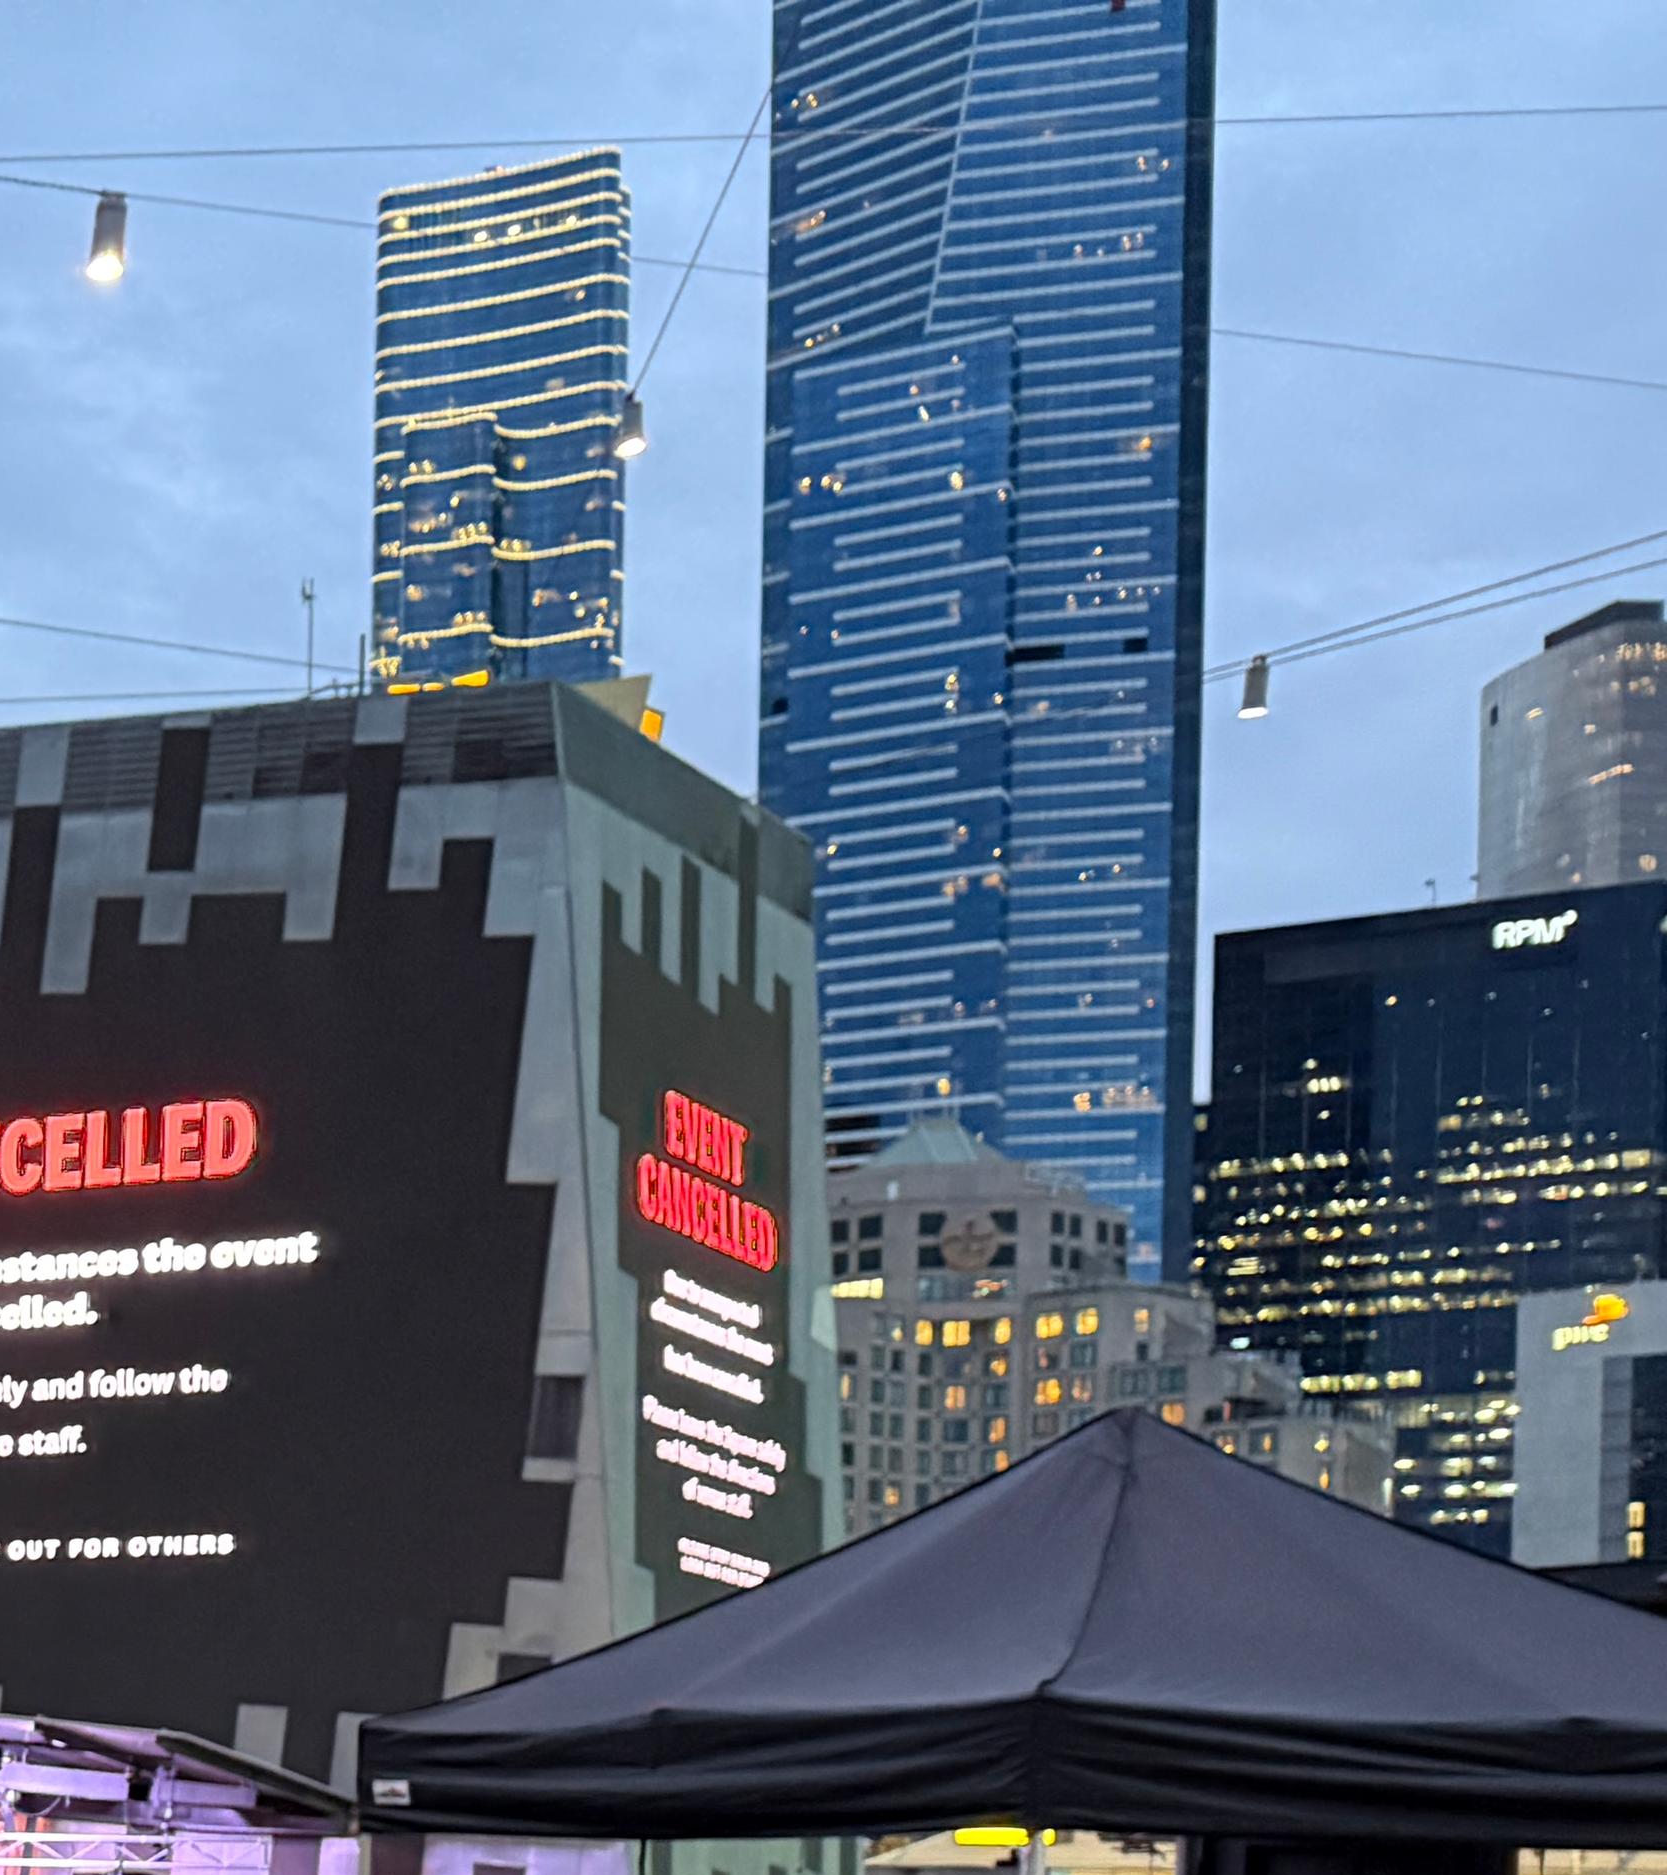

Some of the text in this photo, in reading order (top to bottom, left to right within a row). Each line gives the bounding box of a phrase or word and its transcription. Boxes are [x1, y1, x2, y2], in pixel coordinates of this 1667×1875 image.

[1492, 916, 1568, 950] RPM
[664, 1089, 749, 1187] EVENT
[637, 1153, 778, 1272] CANCELLED
[142, 1237, 207, 1274] the
[210, 1231, 320, 1269] event
[31, 1370, 84, 1401] and
[88, 1367, 175, 1398] follow
[179, 1363, 228, 1394] the
[18, 1424, 87, 1456] staff.
[7, 1539, 61, 1561] OUT
[68, 1537, 120, 1559] FOR
[127, 1533, 235, 1557] OTHERS
